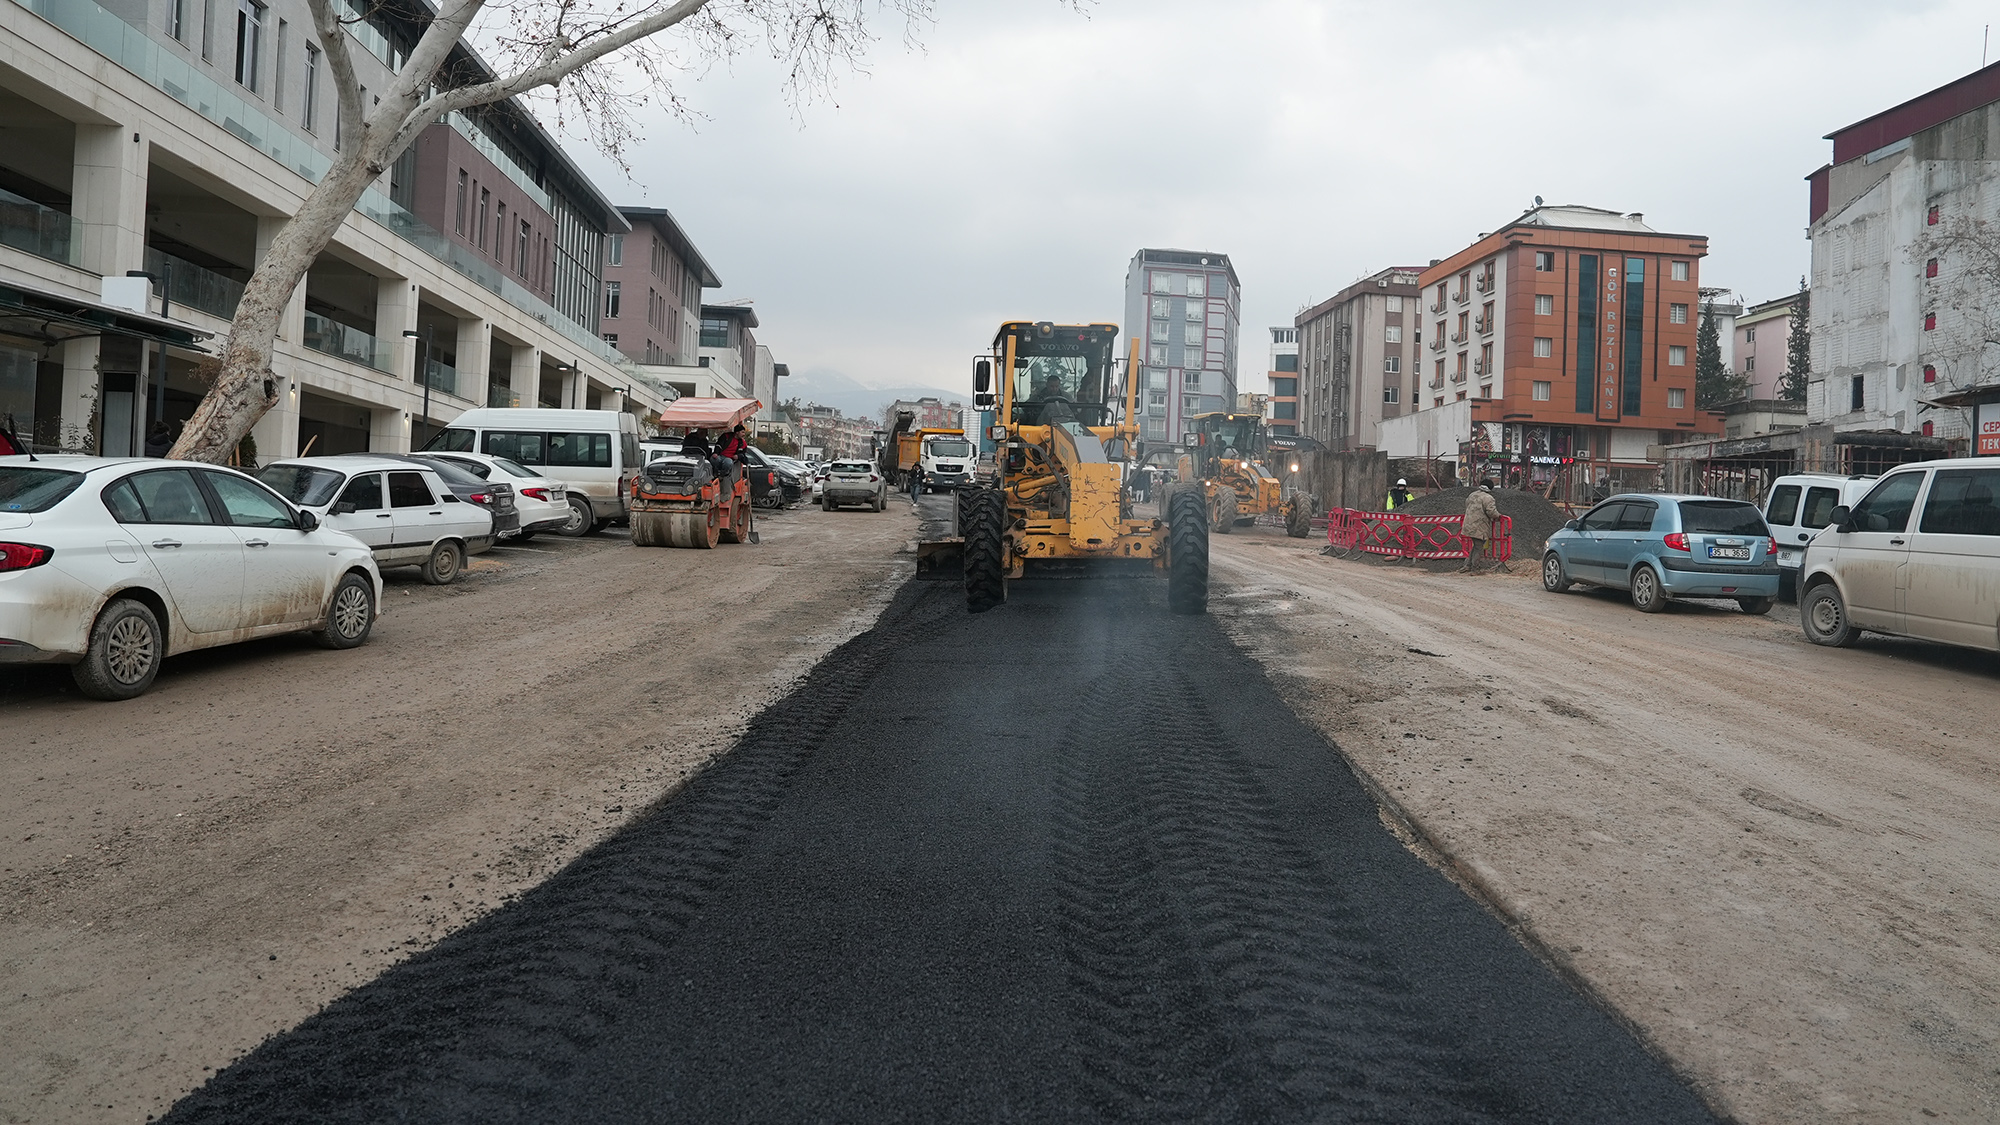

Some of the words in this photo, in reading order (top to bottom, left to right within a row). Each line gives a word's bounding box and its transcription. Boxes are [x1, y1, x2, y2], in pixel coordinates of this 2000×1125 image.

[1606, 268, 1617, 303] GÖK
[1604, 311, 1616, 410] REZİDANS
[1530, 455, 1561, 465] PANENKA
